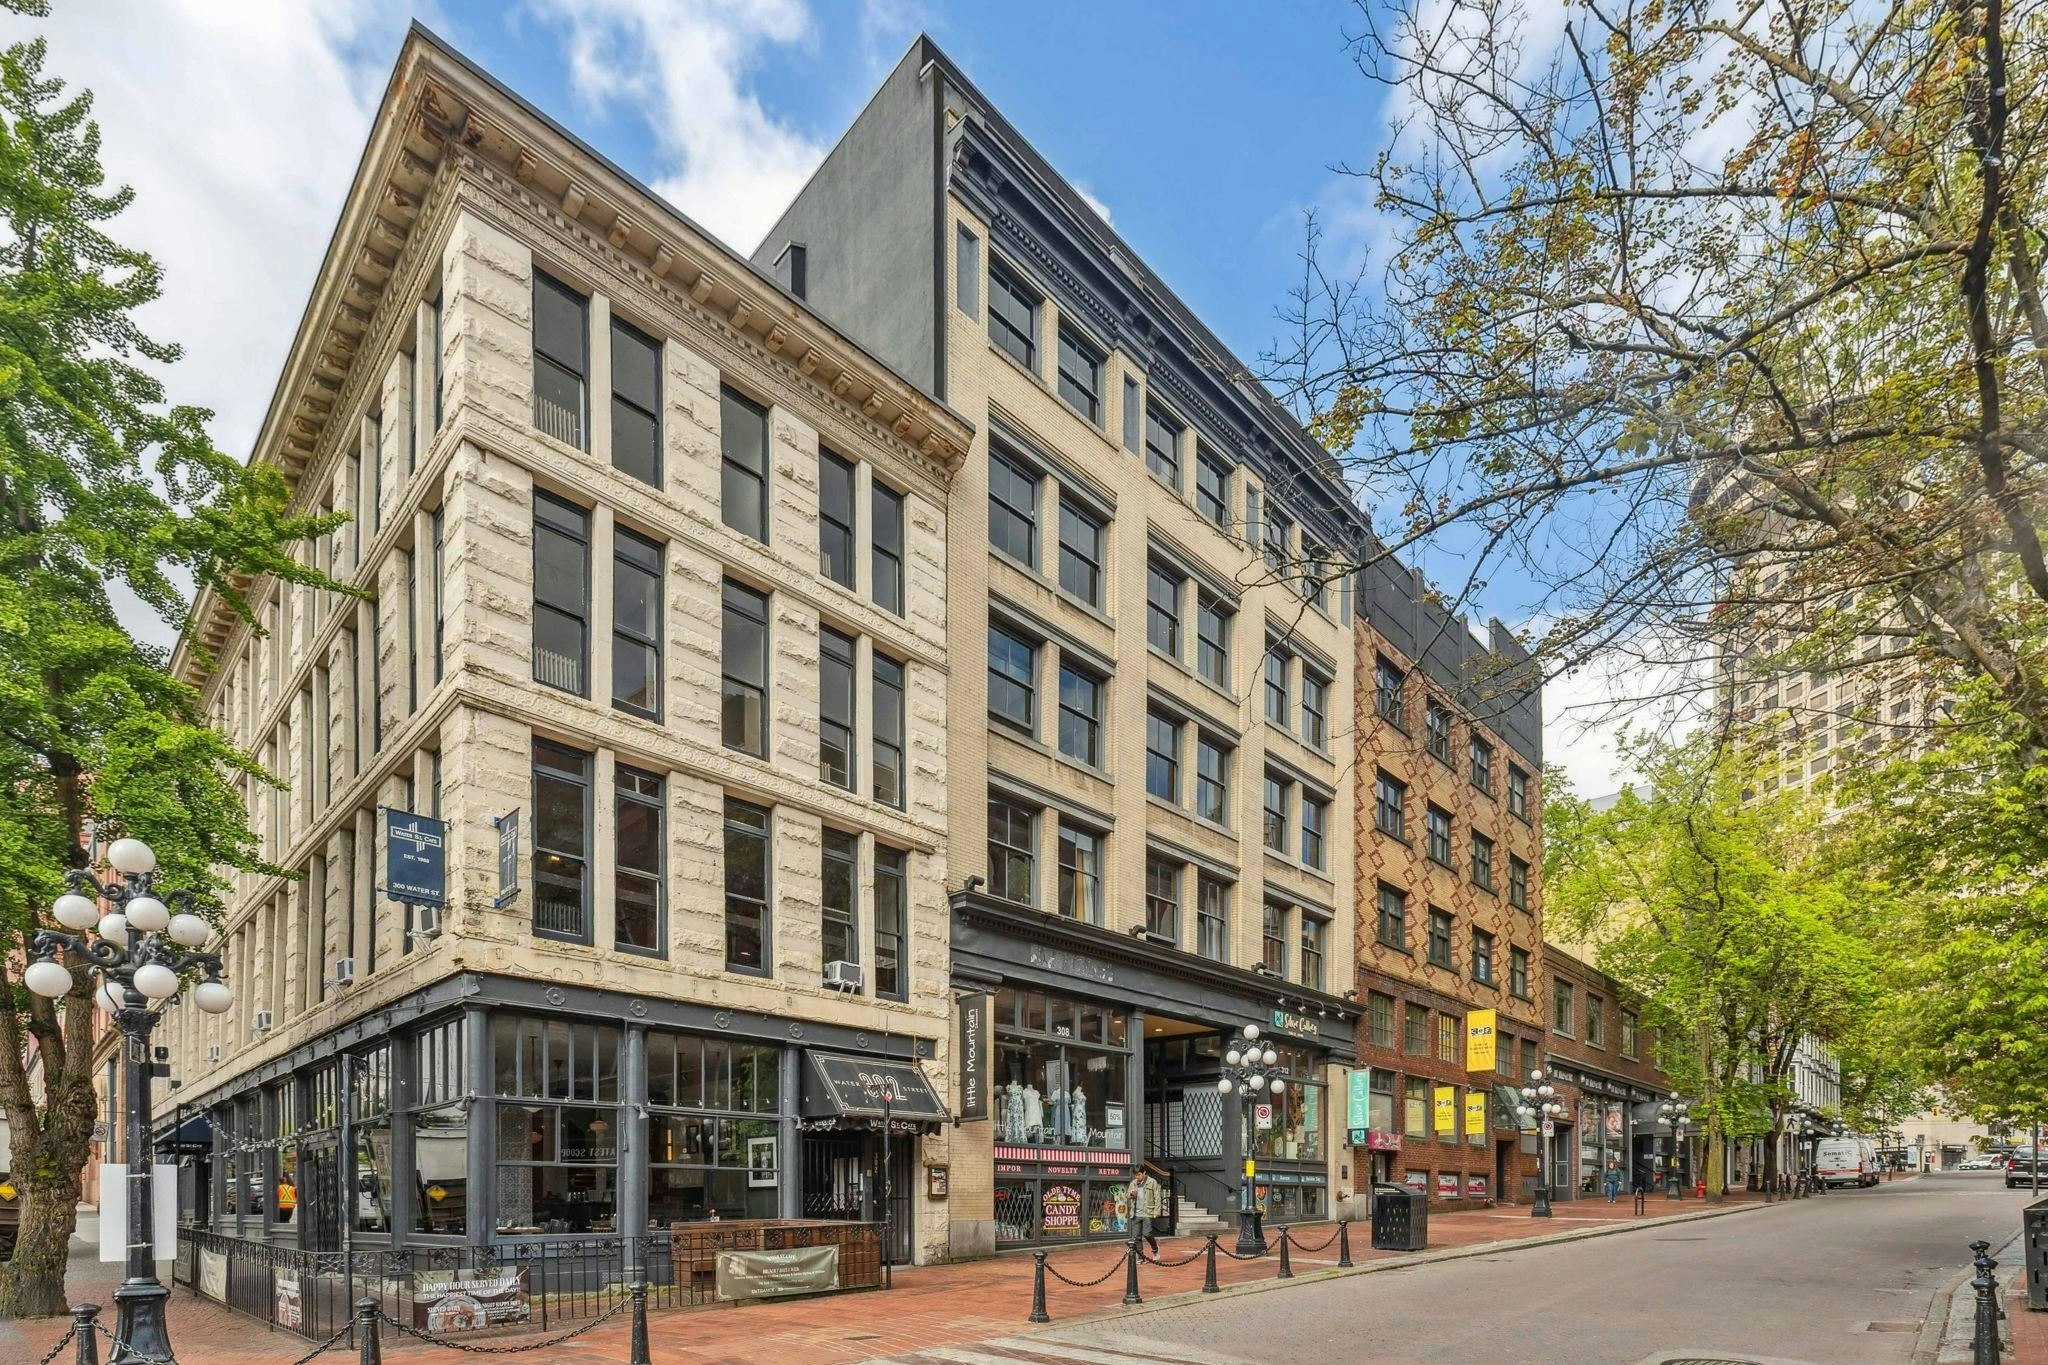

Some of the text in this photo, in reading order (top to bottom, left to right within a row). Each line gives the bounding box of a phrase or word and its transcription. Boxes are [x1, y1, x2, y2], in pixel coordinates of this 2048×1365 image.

[392, 882, 406, 890] 300
[406, 884, 430, 894] WATER
[1056, 1026, 1070, 1037] 308
[965, 1008, 976, 1108] little Mountain
[833, 1079, 861, 1087] WATER
[902, 1086, 928, 1094] STREET
[997, 1164, 1021, 1172] IMPOR
[1047, 1166, 1078, 1174] NOVELTY
[1043, 1186, 1081, 1201] OLDE TYME
[1045, 1204, 1078, 1215] CANDY
[1044, 1215, 1079, 1226] SHOPPE
[422, 1276, 521, 1292] HAPPY HOUR SERVED DAILY
